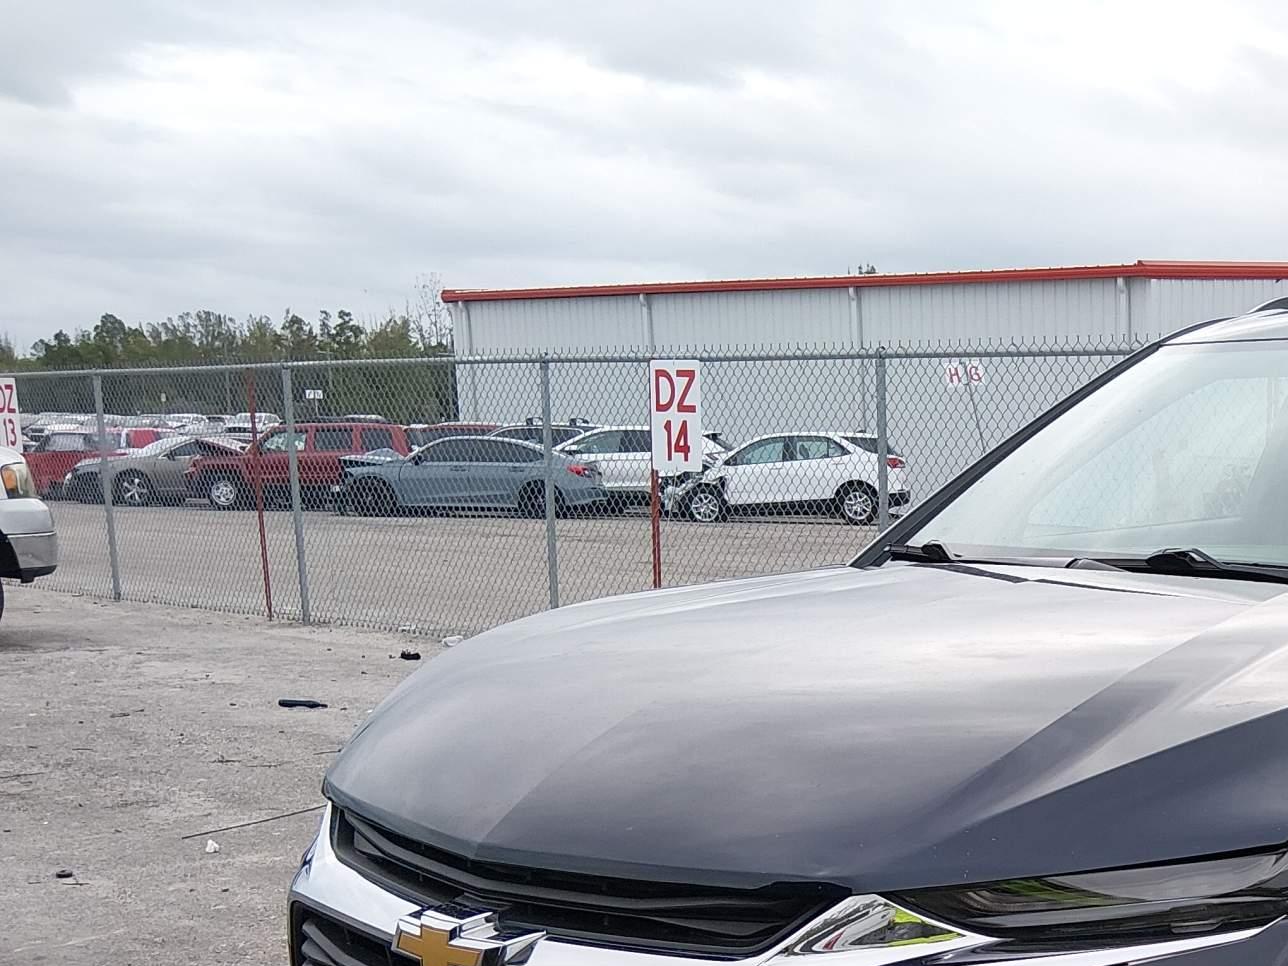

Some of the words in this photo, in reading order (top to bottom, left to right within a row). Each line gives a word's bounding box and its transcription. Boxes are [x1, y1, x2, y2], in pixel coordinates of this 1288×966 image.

[654, 368, 697, 413] DZ
[948, 367, 961, 383] H
[3, 418, 17, 447] 13
[663, 419, 691, 462] 14
